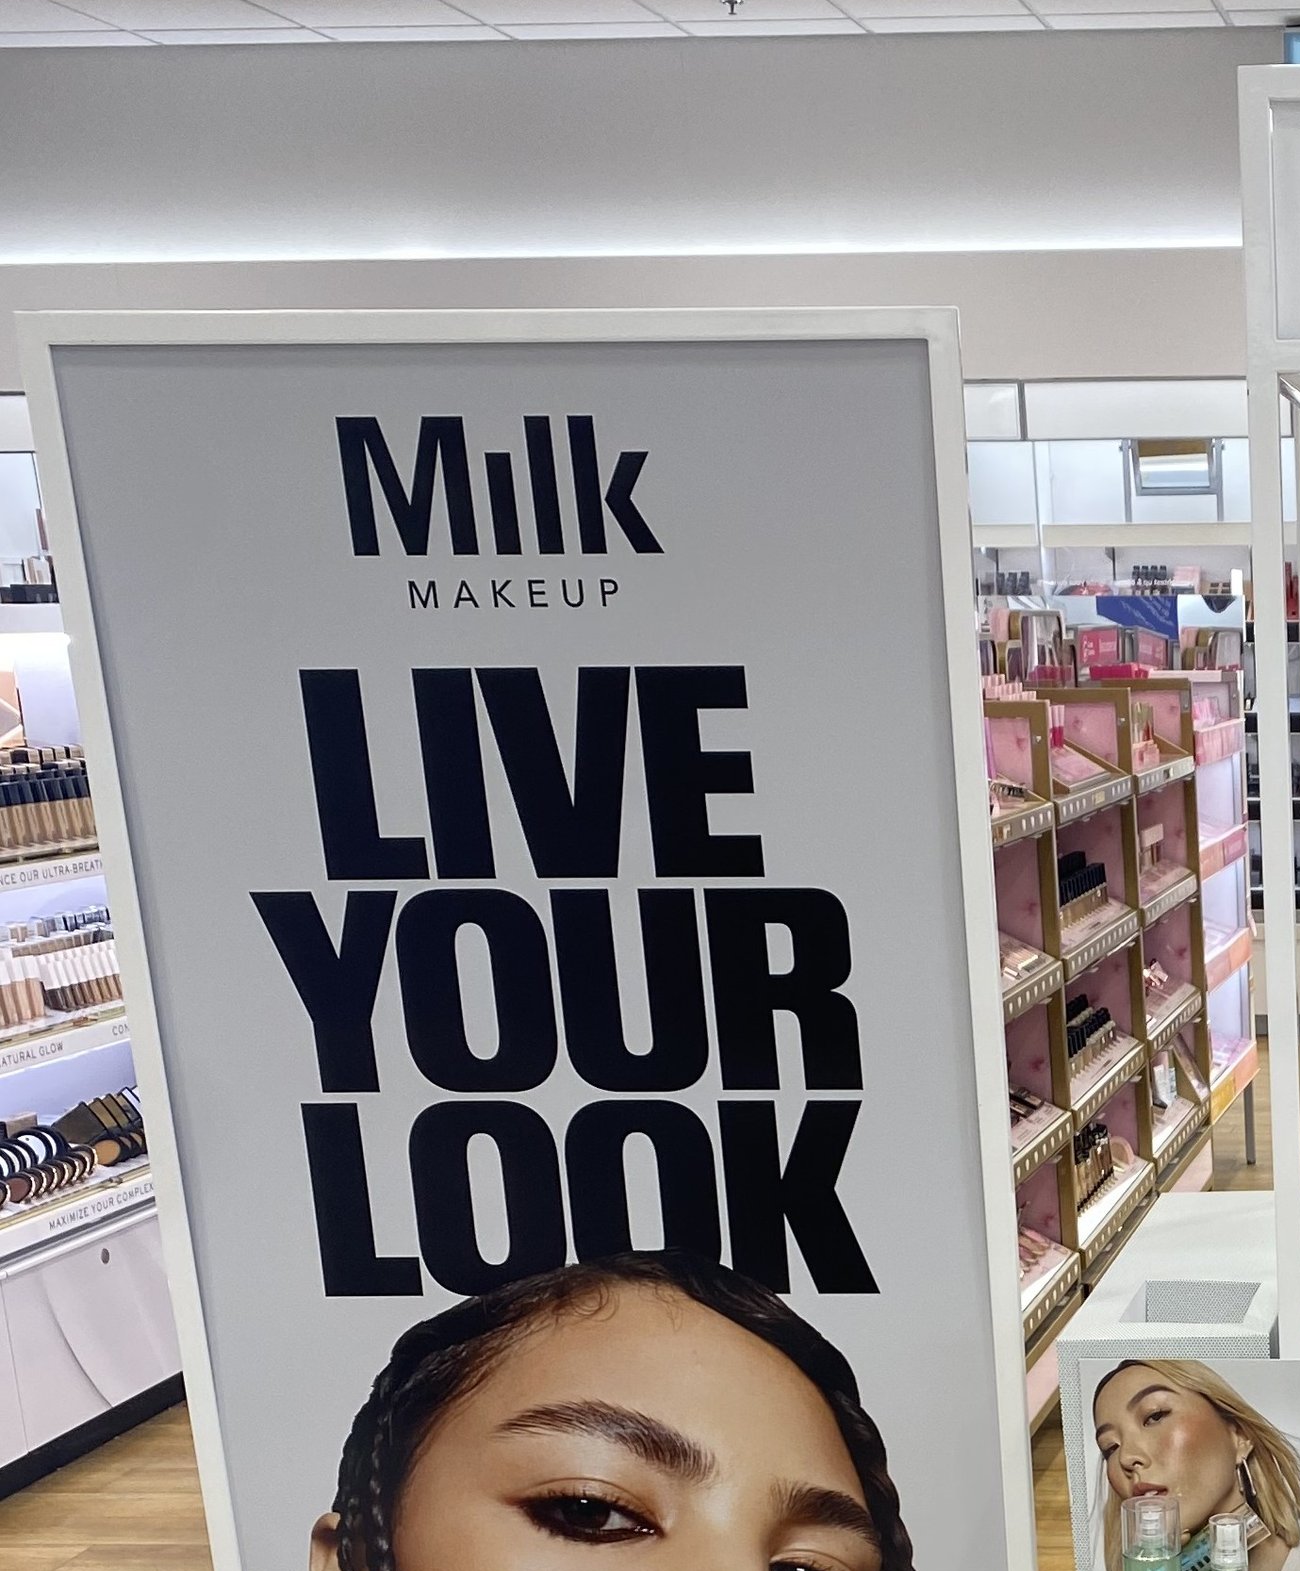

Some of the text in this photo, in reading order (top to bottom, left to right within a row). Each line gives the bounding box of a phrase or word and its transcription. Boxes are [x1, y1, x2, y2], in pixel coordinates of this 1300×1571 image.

[335, 414, 664, 557] Milk
[407, 578, 621, 609] MAKEUP
[299, 665, 765, 880] LIVE
[20, 870, 40, 885] OUR
[249, 887, 863, 1093] YOUR
[39, 1041, 64, 1060] GLOW
[49, 1207, 89, 1231] MAXIMIZE
[90, 1197, 115, 1219] YOUR
[300, 1099, 881, 1297] LOOK
